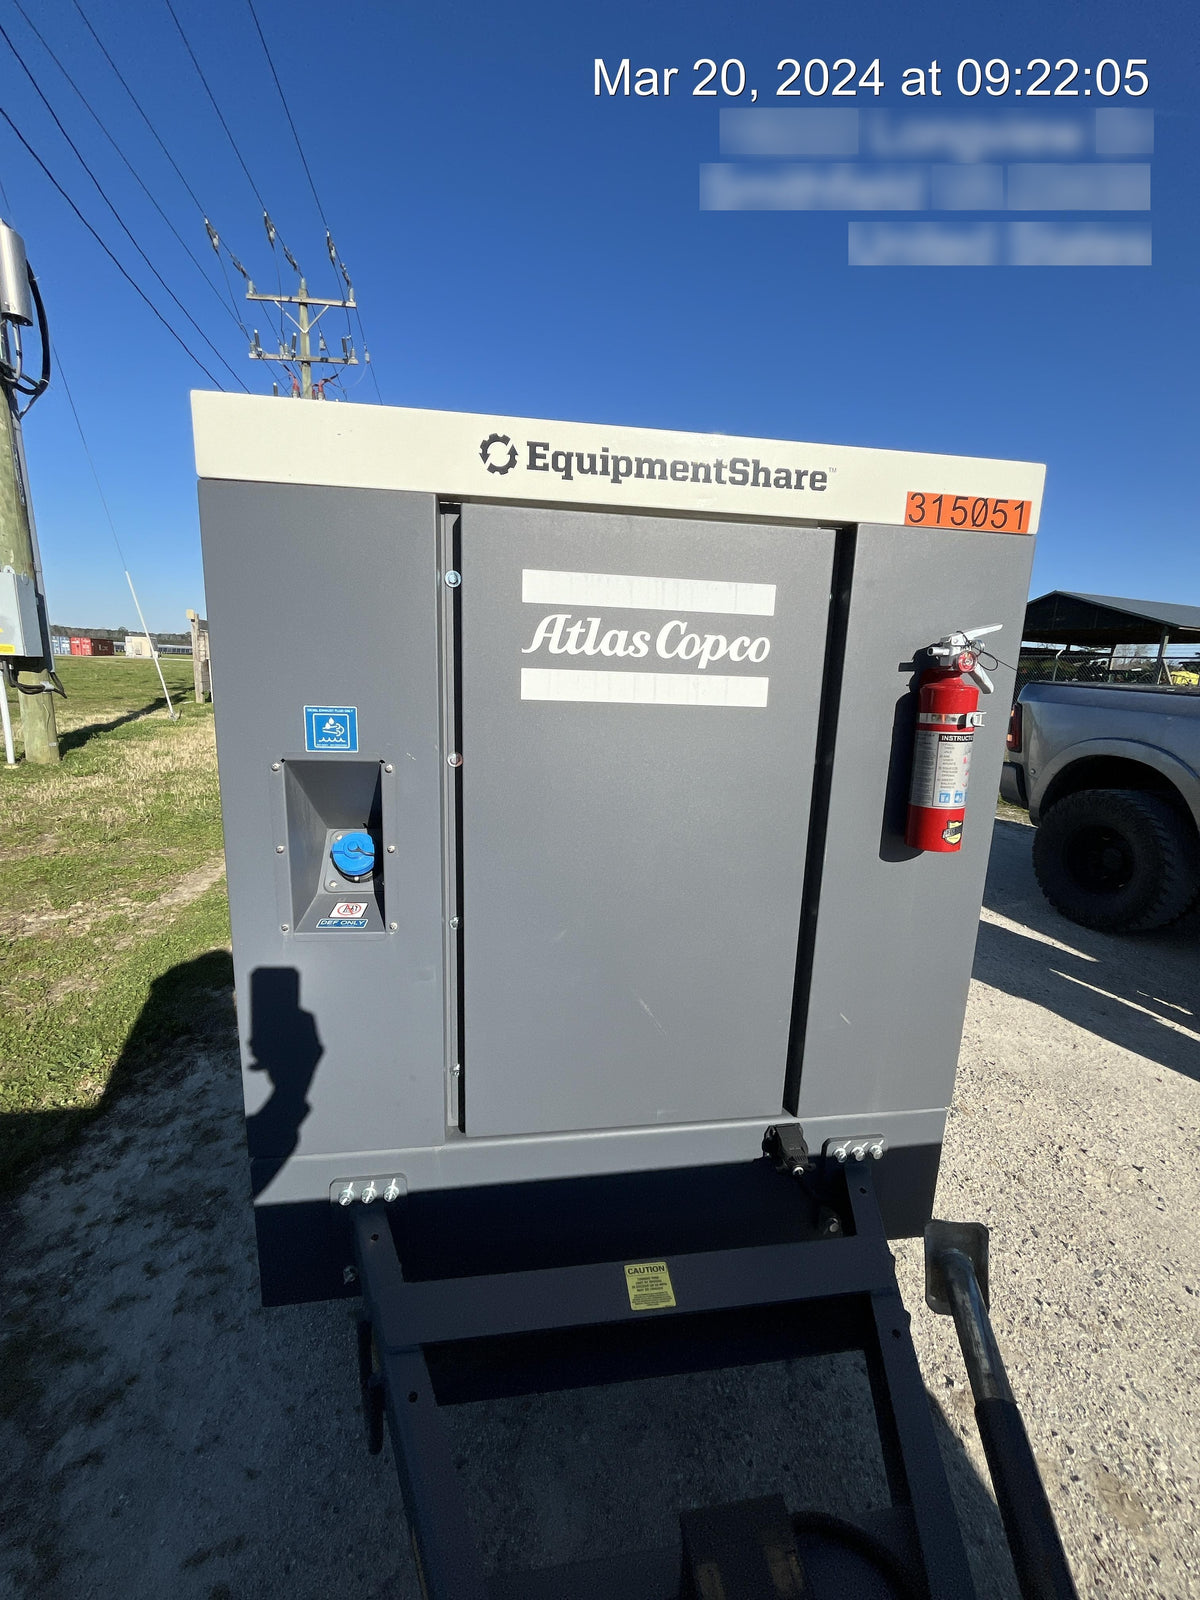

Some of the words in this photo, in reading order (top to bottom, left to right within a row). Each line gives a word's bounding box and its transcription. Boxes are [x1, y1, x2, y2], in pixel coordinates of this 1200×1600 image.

[526, 440, 828, 492] EquipmentShare
[908, 492, 1025, 530] 315051
[521, 613, 651, 658] Atlas
[655, 619, 771, 669] Copco
[627, 1265, 665, 1275] CAUTION
